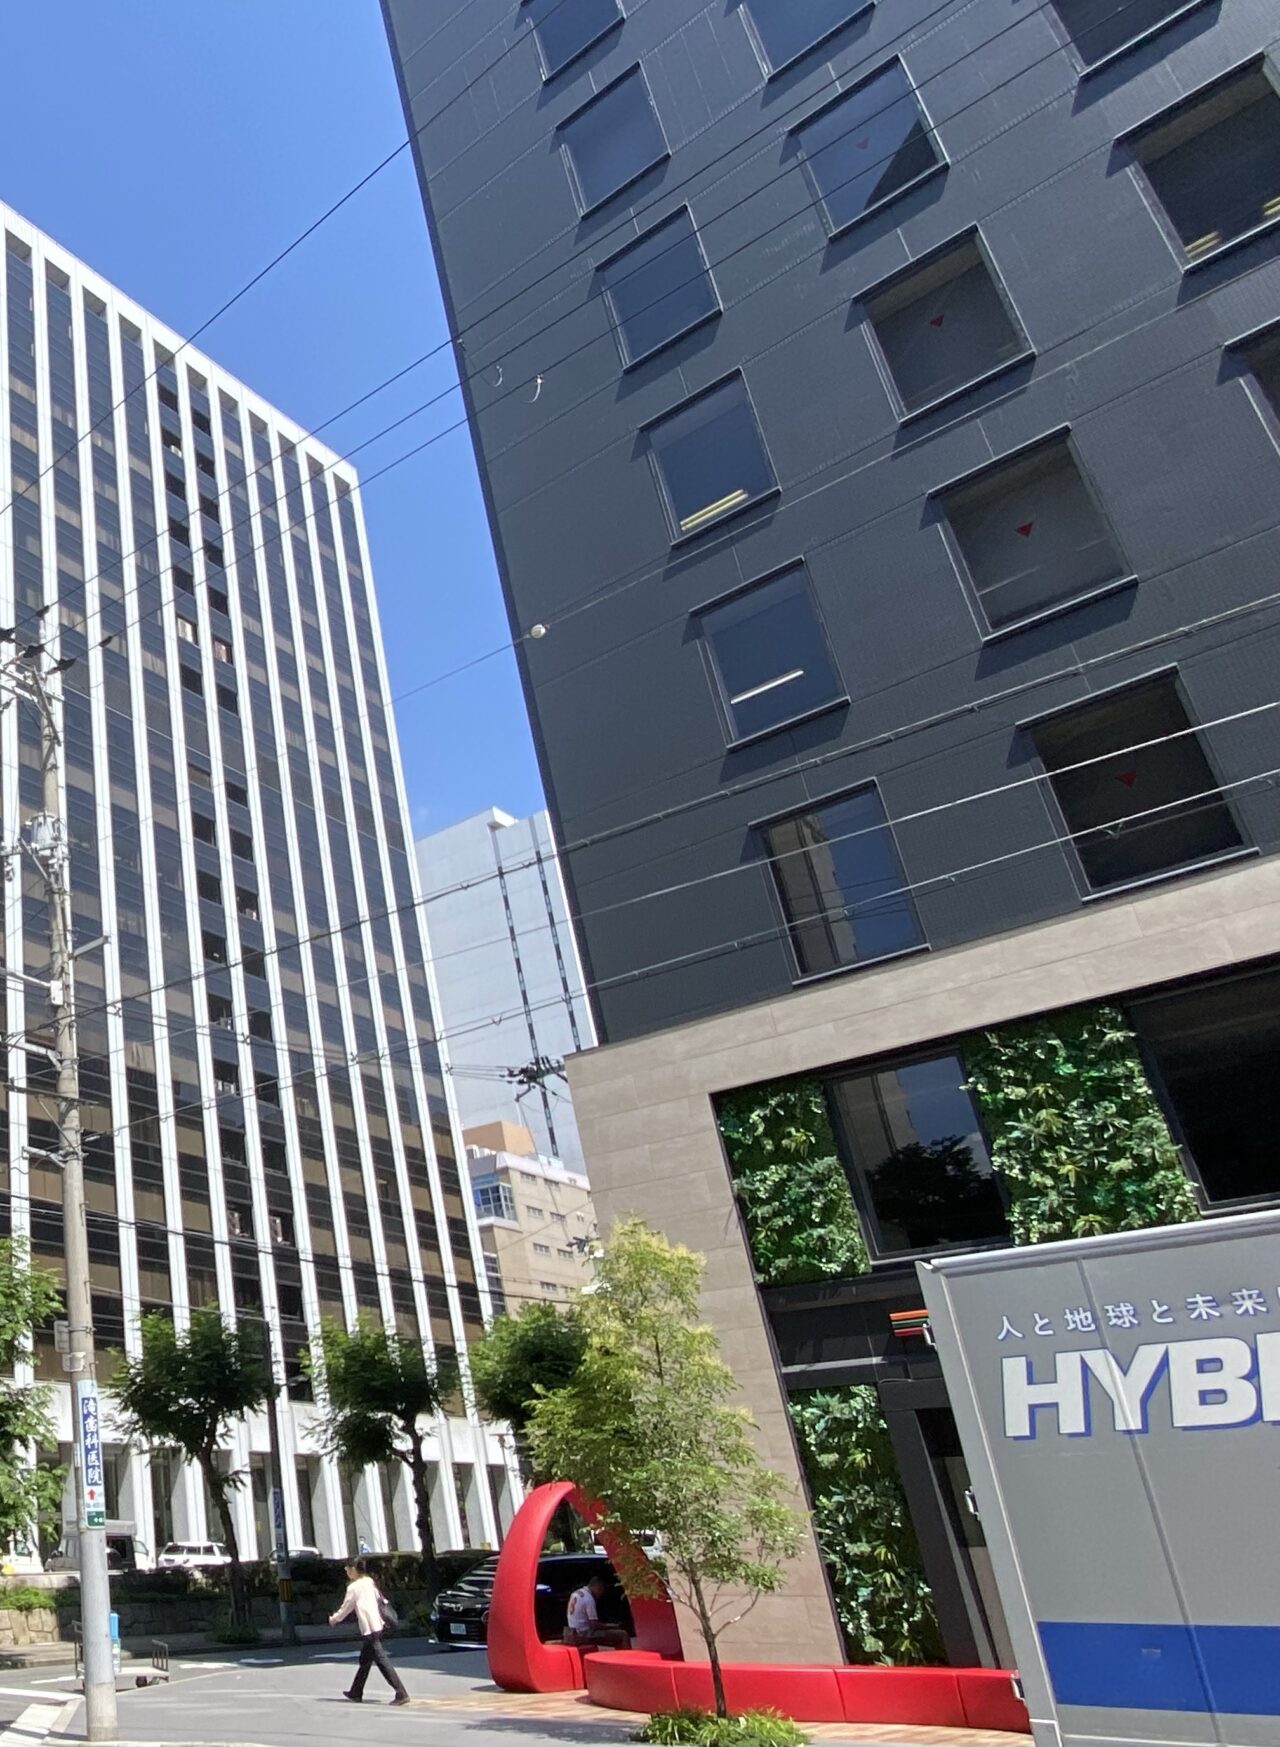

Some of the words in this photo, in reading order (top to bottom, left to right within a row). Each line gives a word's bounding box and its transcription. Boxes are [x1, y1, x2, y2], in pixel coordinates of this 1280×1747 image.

[997, 1287, 1280, 1341] 人と地球と未来
